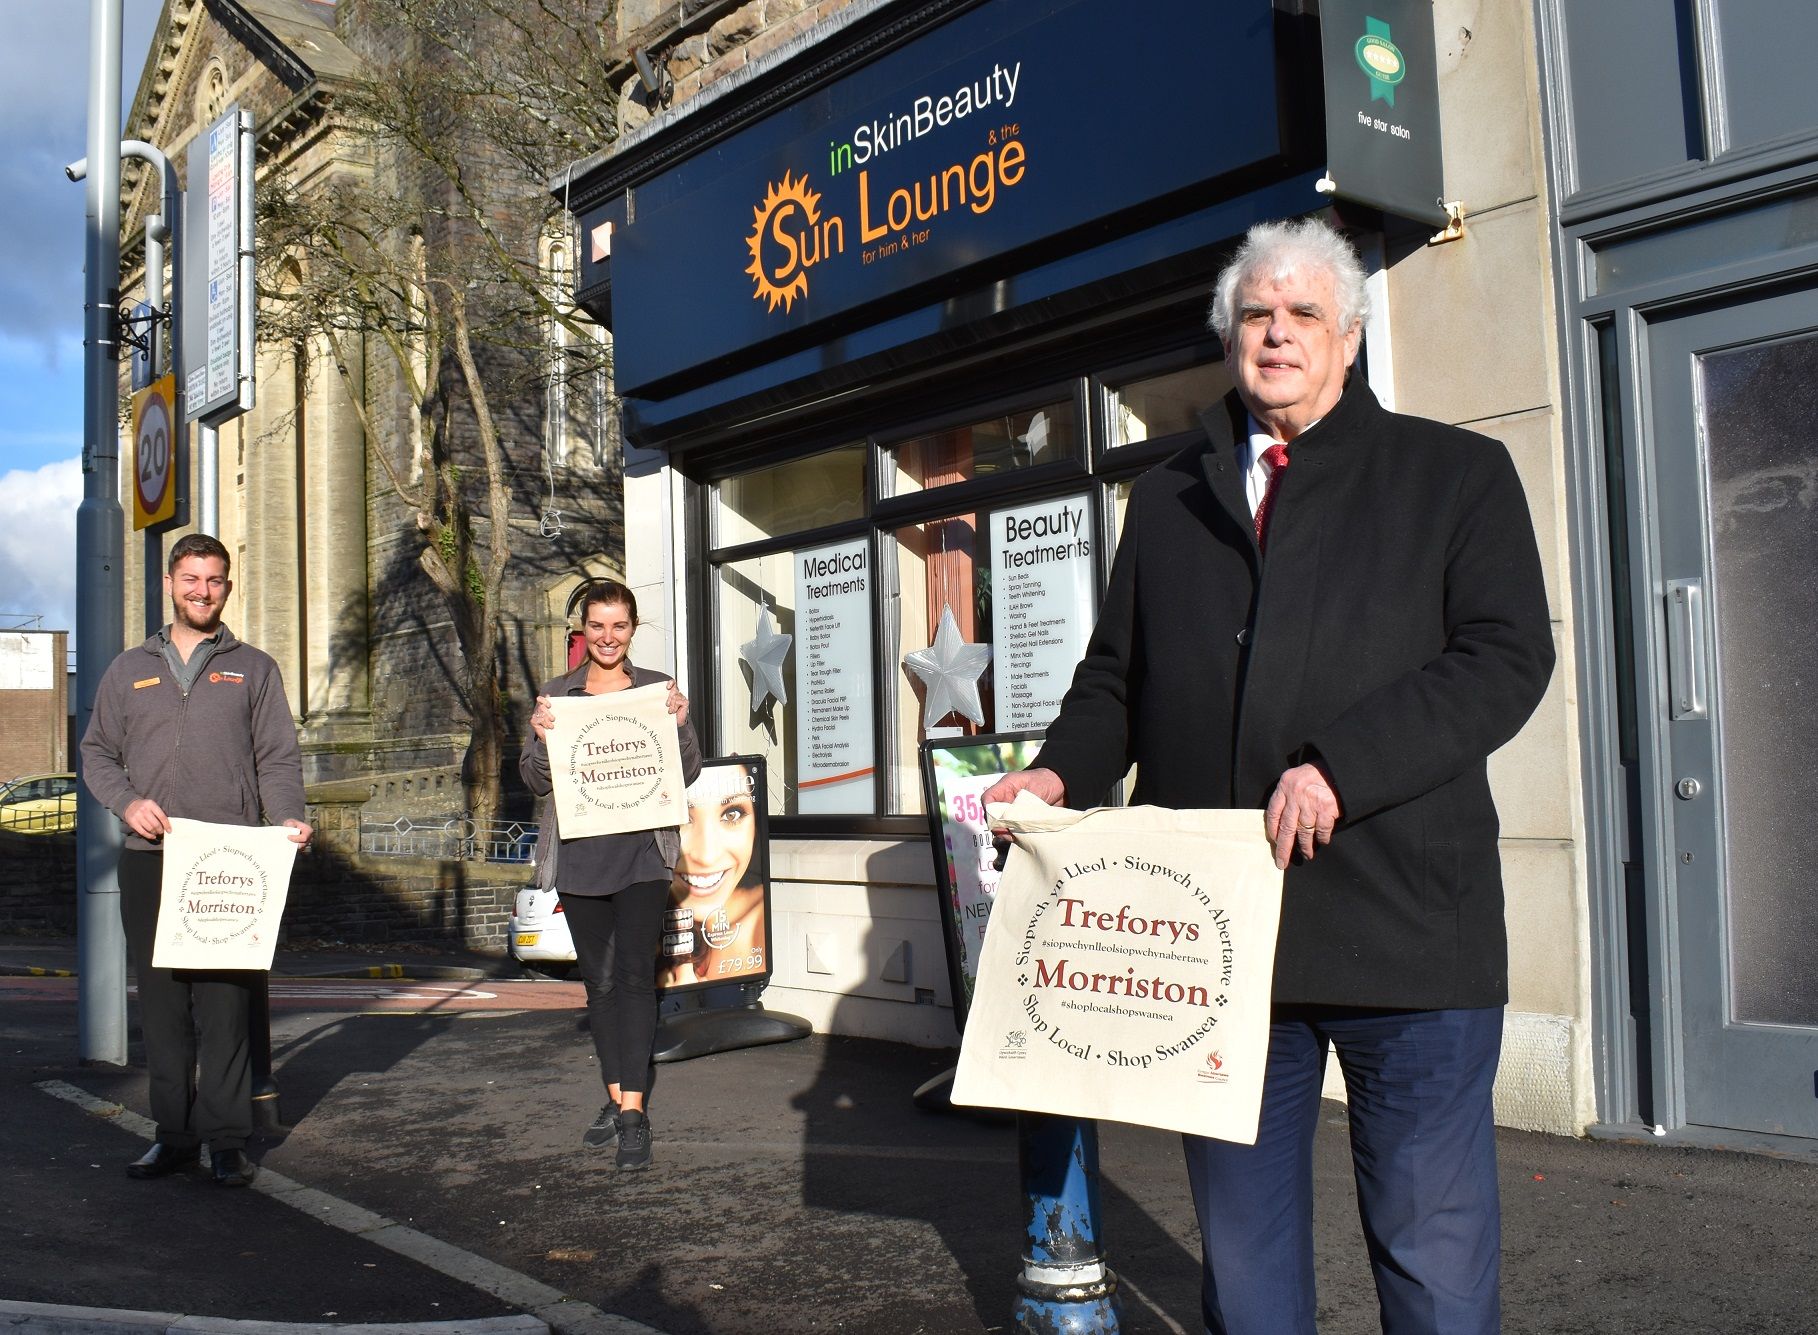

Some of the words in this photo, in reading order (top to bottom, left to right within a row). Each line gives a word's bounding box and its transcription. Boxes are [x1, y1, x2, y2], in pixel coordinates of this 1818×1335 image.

[830, 62, 1021, 176] inSkinBeauty
[1358, 111, 1371, 126] five
[1374, 119, 1387, 133] star
[1390, 124, 1410, 140] salon
[988, 130, 997, 145] &
[1001, 122, 1020, 141] the
[773, 203, 844, 279] Sun
[859, 140, 1026, 244] Lounge
[862, 249, 876, 265] for
[879, 241, 897, 260] him
[901, 238, 909, 250] &
[912, 229, 930, 247] her
[142, 427, 165, 482] 20
[1006, 505, 1083, 543] Beauty
[804, 547, 866, 580] Medical
[1002, 537, 1089, 569] Treatments
[807, 576, 865, 600] Treatments
[1022, 589, 1045, 597] Whitening
[1040, 618, 1065, 626] Treatments
[1010, 632, 1026, 640] Shellac
[1039, 638, 1063, 646] Extensions
[1011, 661, 1031, 669] Piercings
[1022, 650, 1033, 658] Nails
[1012, 701, 1041, 709] Non-Surgical
[605, 714, 638, 725] Siopwch
[1012, 722, 1029, 730] Eyelash
[582, 738, 647, 757] Treforys
[580, 765, 657, 785] Morriston
[578, 786, 594, 803] Shop
[594, 798, 614, 810] Local
[621, 800, 640, 810] Shop
[196, 870, 254, 889] Treforys
[186, 899, 255, 914] Morriston
[712, 921, 730, 932] MIN
[1016, 901, 1050, 966] Siopwch
[1050, 879, 1065, 897] yn
[1064, 857, 1107, 879] Lleol
[1124, 855, 1192, 889] Siopwch
[1191, 887, 1211, 906] yn
[1208, 908, 1234, 986] Abertawe
[1056, 898, 1200, 945] Treforys
[1042, 938, 1209, 965] #siopwchynlleolsiopwchynabertawe
[718, 954, 763, 974] £79.99
[1033, 959, 1210, 1008] Morriston
[1061, 1000, 1174, 1022] #shoplocalshopswansea
[1023, 993, 1048, 1032] Shop
[1048, 1026, 1092, 1061] Local
[1107, 1050, 1152, 1069] Shop
[1155, 1016, 1218, 1061] Swansea
